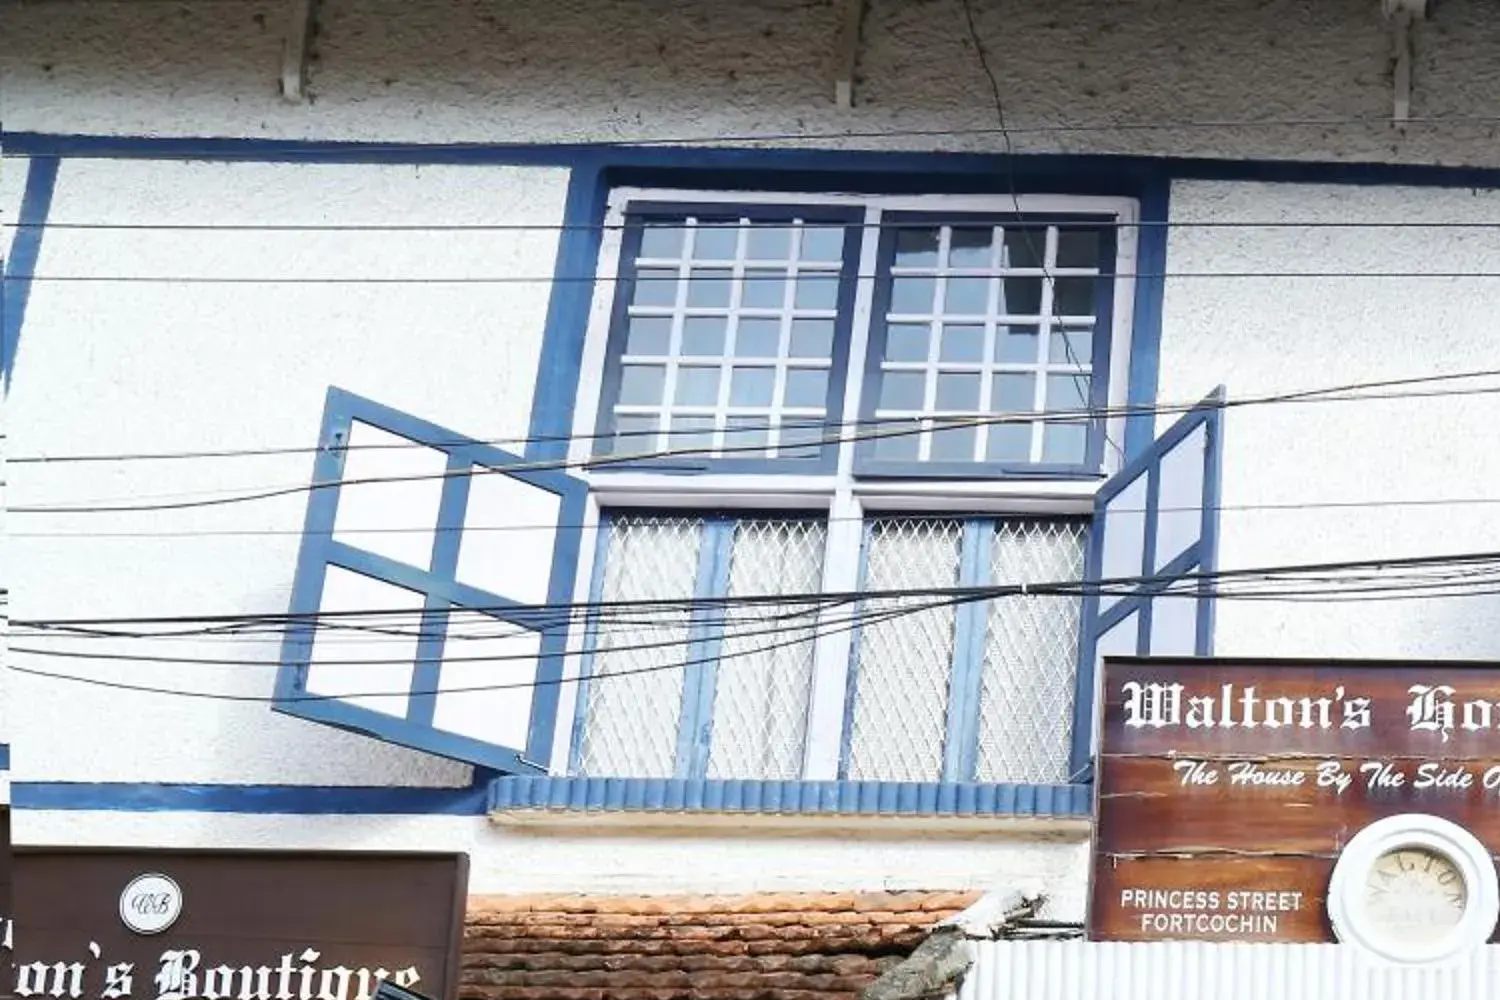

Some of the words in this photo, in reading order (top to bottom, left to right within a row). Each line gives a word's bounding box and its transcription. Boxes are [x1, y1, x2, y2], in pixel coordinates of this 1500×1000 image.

[1121, 681, 1372, 730] Walton's
[1174, 760, 1219, 787] The
[1228, 762, 1306, 786] House
[1316, 761, 1352, 795] By
[1360, 762, 1406, 789] The
[1413, 763, 1474, 789] Side
[1120, 889, 1221, 909] PRINCESS
[1227, 891, 1303, 911] STREET
[1141, 913, 1278, 934] FORTCOCHIN
[12, 941, 135, 999] on's
